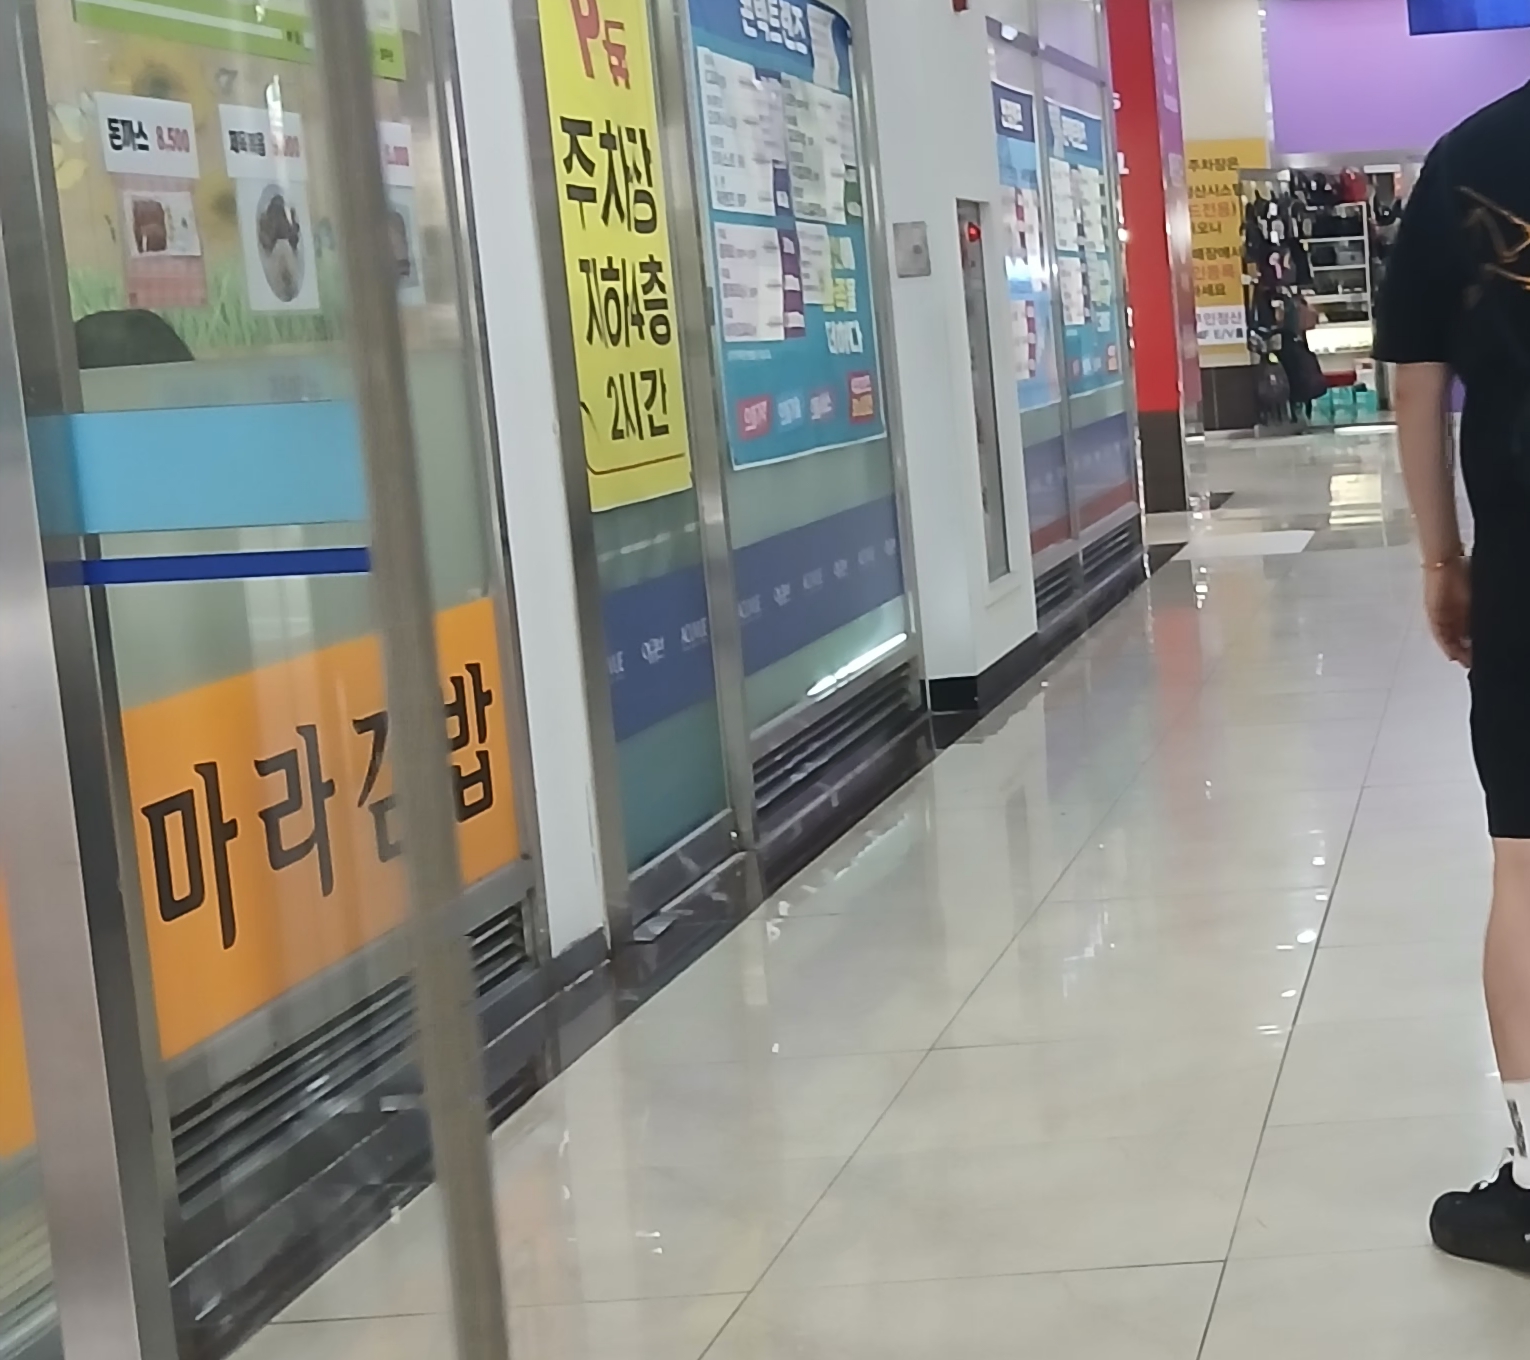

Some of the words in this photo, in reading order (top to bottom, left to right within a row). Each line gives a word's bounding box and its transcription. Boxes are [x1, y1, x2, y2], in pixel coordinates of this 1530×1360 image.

[560, 115, 658, 234] 주차장
[579, 254, 671, 349] 지하4층
[607, 368, 670, 441] 2시간
